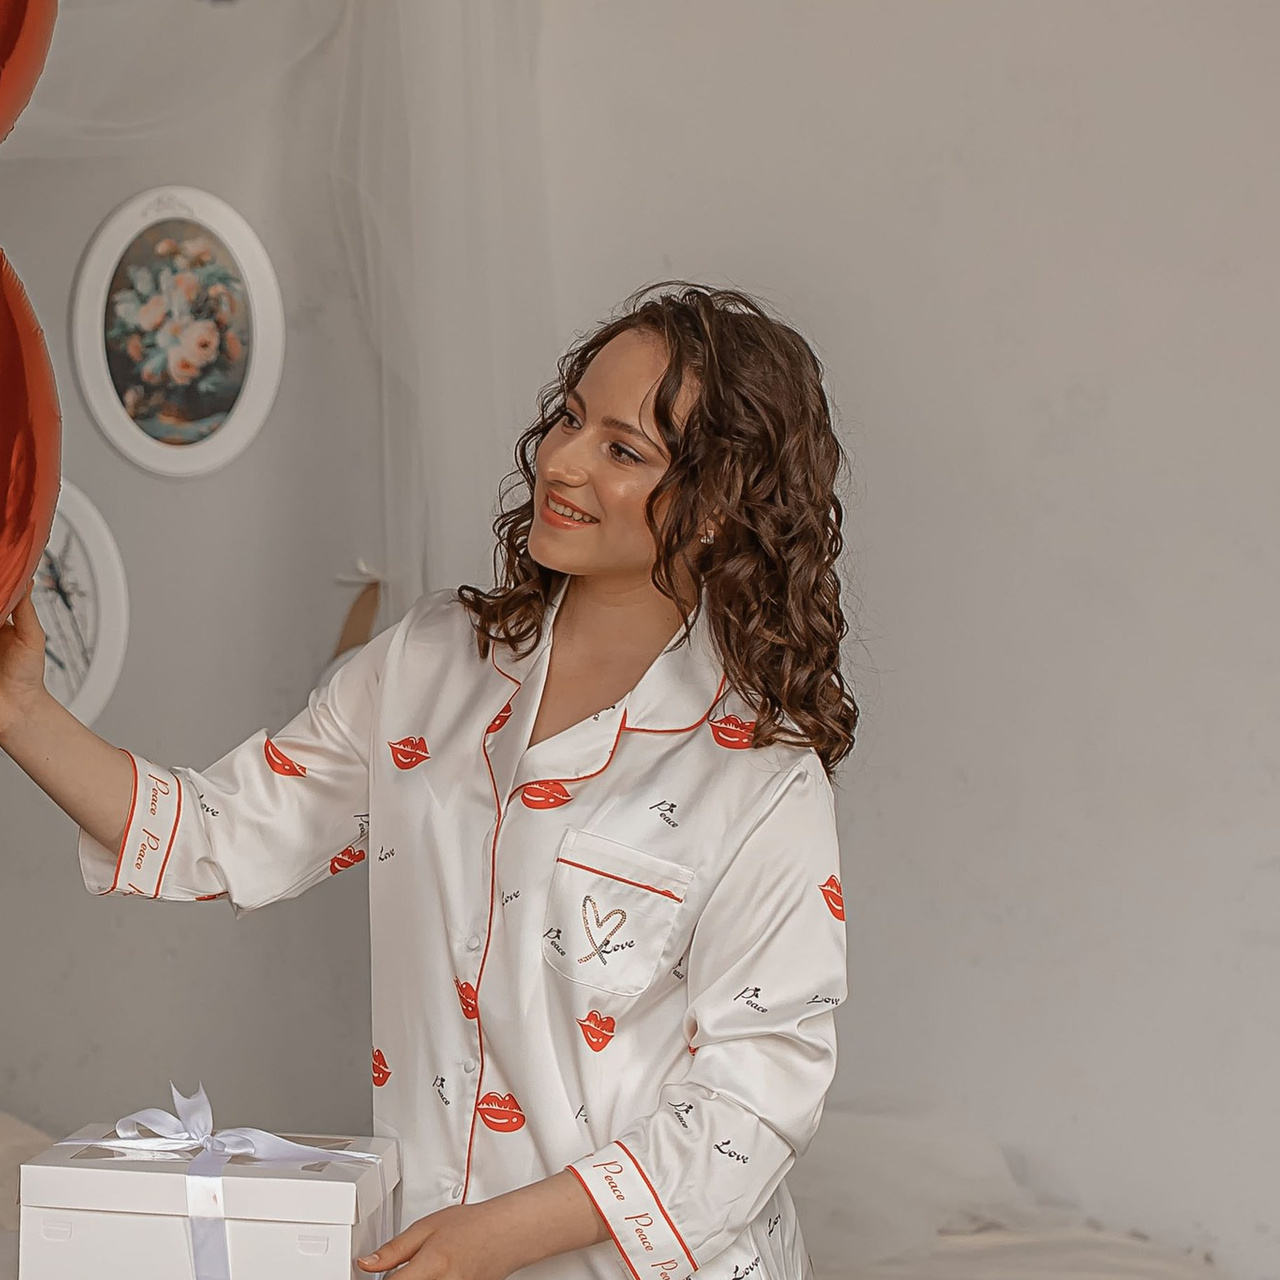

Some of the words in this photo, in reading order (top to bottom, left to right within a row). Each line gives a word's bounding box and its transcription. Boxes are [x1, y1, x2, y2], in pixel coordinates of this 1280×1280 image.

[649, 800, 679, 829] Peace
[542, 927, 567, 957] Peace
[601, 939, 636, 955] Love
[733, 986, 769, 1014] Peace
[668, 1101, 694, 1129] Peace
[713, 1139, 750, 1164] Love
[592, 1160, 626, 1202] Peace
[624, 1212, 654, 1253] Peace
